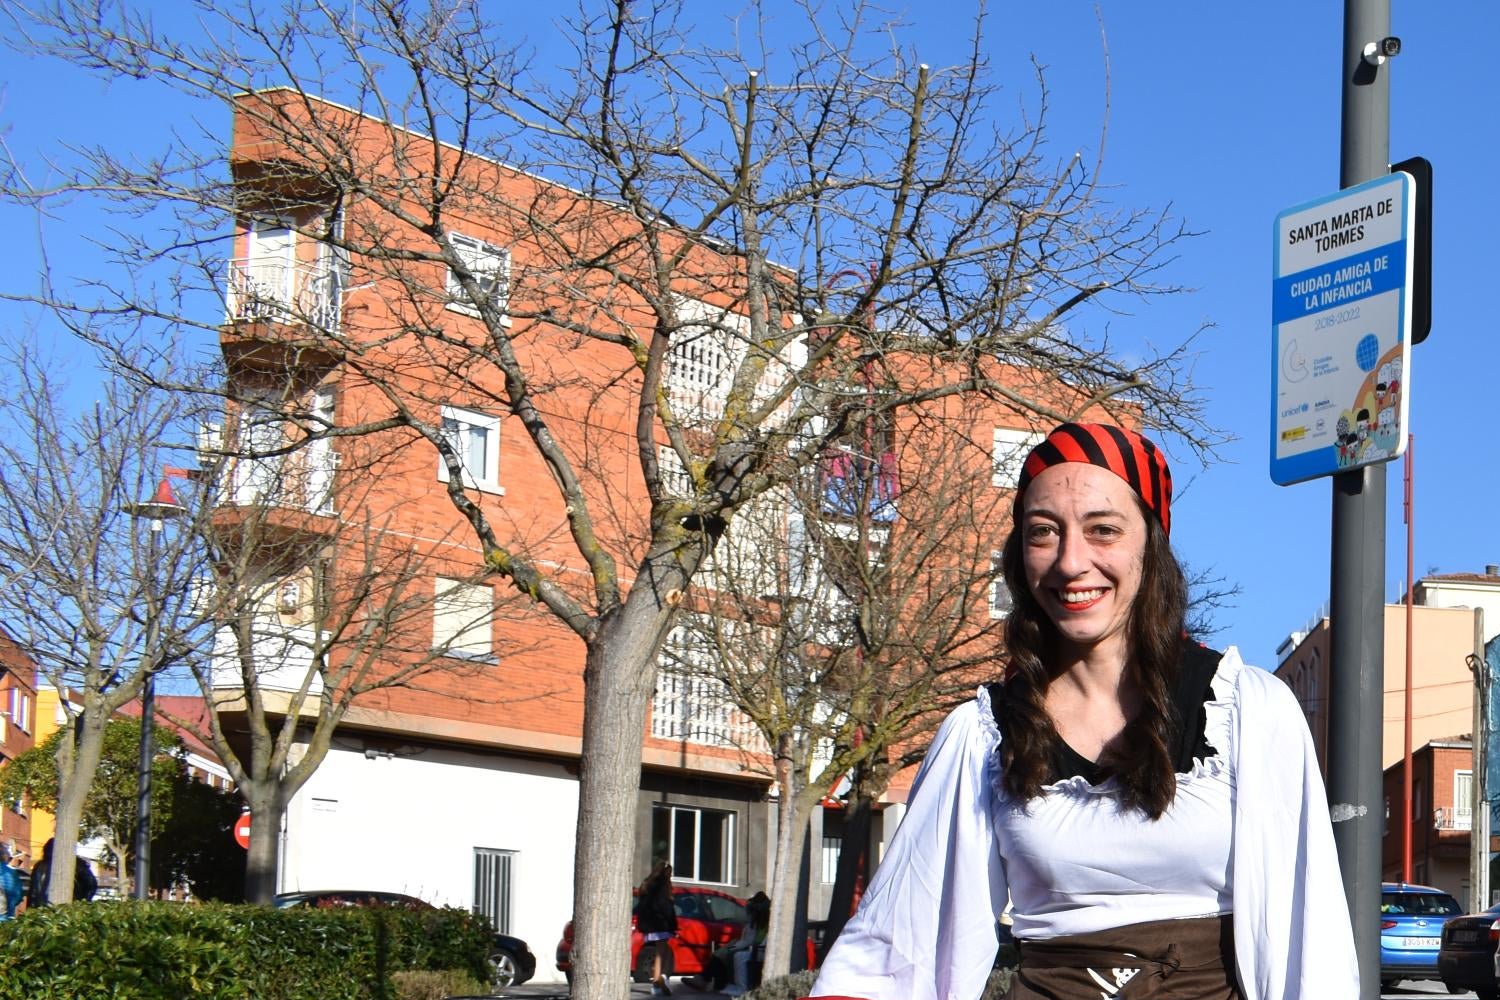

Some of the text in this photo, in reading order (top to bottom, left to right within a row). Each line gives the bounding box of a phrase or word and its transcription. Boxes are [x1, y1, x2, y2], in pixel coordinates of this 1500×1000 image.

[1289, 198, 1393, 245] SANTA MARTA DE
[1315, 225, 1365, 253] TORMES
[1290, 255, 1388, 298] CIUDAD AMIGA DE
[1305, 278, 1373, 311] LA INFANCIA
[1315, 307, 1361, 331] 2018-2022
[1281, 403, 1301, 418] unicef
